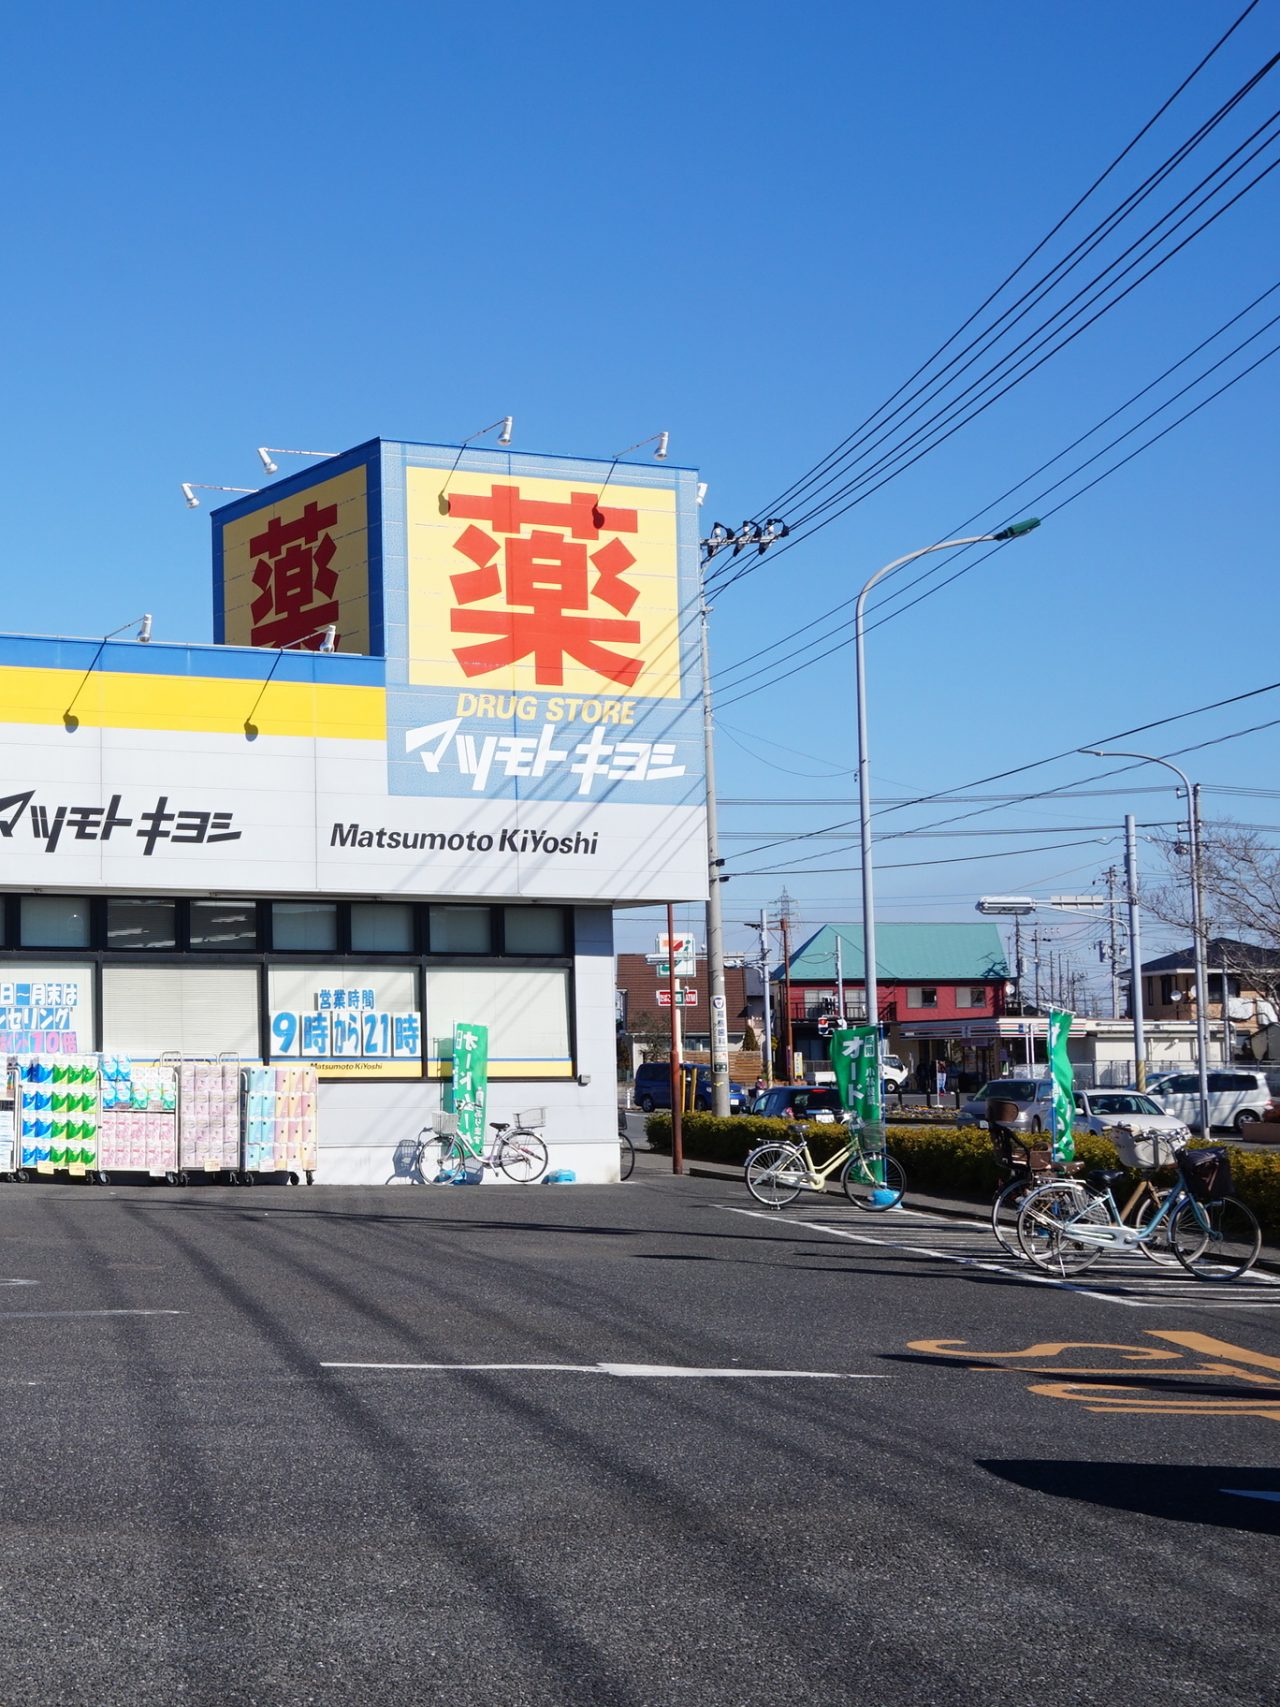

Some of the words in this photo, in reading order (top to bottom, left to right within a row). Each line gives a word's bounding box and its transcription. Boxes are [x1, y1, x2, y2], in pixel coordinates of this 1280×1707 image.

[249, 501, 340, 656] 薬
[448, 484, 645, 687] 薬
[456, 693, 537, 720] DRUG
[545, 697, 636, 724] STORE
[406, 717, 686, 794] マツモトキヨシ
[330, 823, 494, 852] Matsumoto
[498, 828, 599, 855] KiYoshi
[320, 989, 375, 1010] 営業時間
[272, 1012, 419, 1055] 9時から21時
[355, 1062, 383, 1070] KiYoshi
